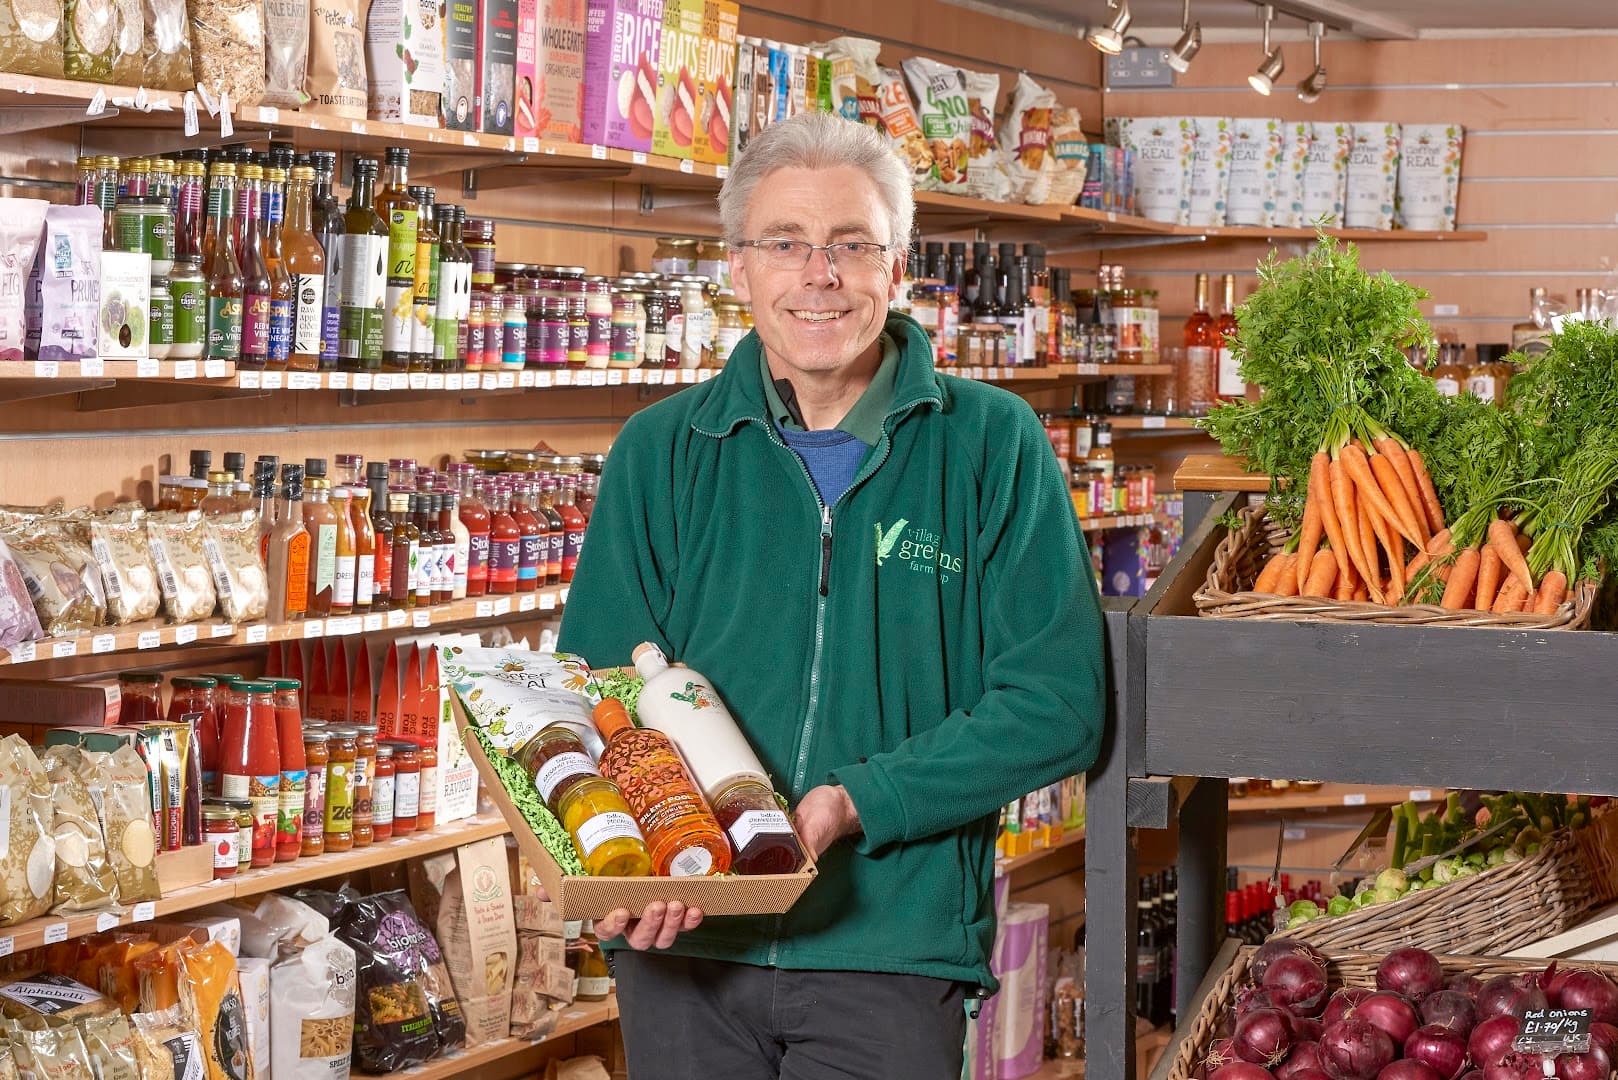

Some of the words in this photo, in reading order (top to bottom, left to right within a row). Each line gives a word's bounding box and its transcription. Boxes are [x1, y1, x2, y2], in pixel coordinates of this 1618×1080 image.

[638, 0, 663, 19] PUFFED
[541, 27, 567, 51] WHOLE
[568, 32, 586, 54] EARTH
[613, 11, 626, 63] BROWN
[621, 15, 662, 71] RICE
[667, 31, 699, 79] OATS
[707, 37, 735, 87] OATS
[1142, 148, 1175, 160] REAL
[1406, 156, 1440, 168] REAL
[2, 274, 20, 298] FIG
[908, 528, 941, 547] villag
[909, 560, 935, 574] farm
[443, 782, 472, 800] RAVIOLI
[639, 800, 666, 825] SILENT
[667, 794, 695, 803] POOL
[1525, 1009, 1545, 1019] Red
[1549, 1009, 1588, 1018] onions
